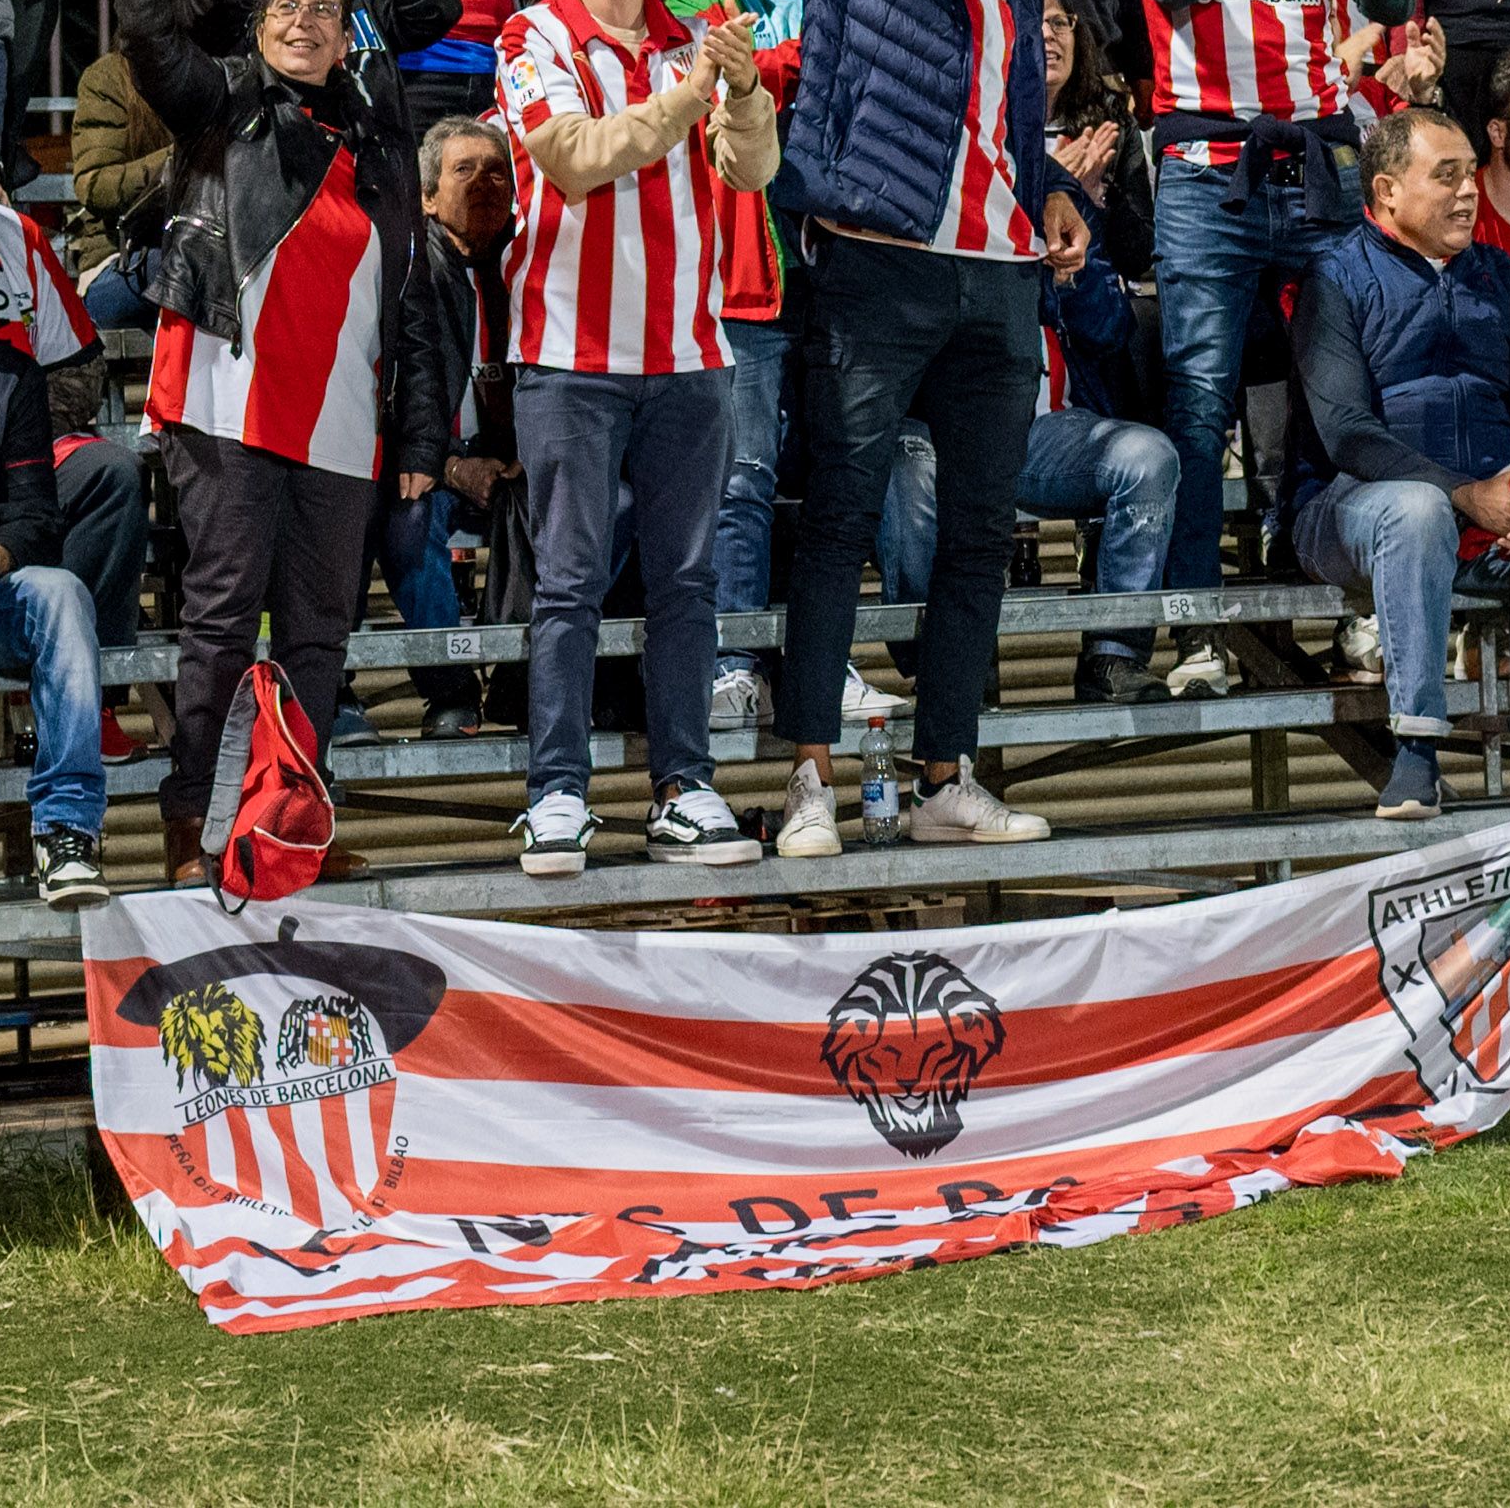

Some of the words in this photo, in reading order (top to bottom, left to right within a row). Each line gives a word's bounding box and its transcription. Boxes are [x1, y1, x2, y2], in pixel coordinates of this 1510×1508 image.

[1170, 598, 1189, 614] 58
[451, 638, 472, 655] 52
[184, 1089, 246, 1124] LEONES
[251, 1088, 273, 1106] DE
[279, 1063, 392, 1103] BARCELONA
[164, 1133, 195, 1177] PEÑA
[193, 1176, 221, 1198] DEL
[384, 1135, 409, 1190] BILBAO
